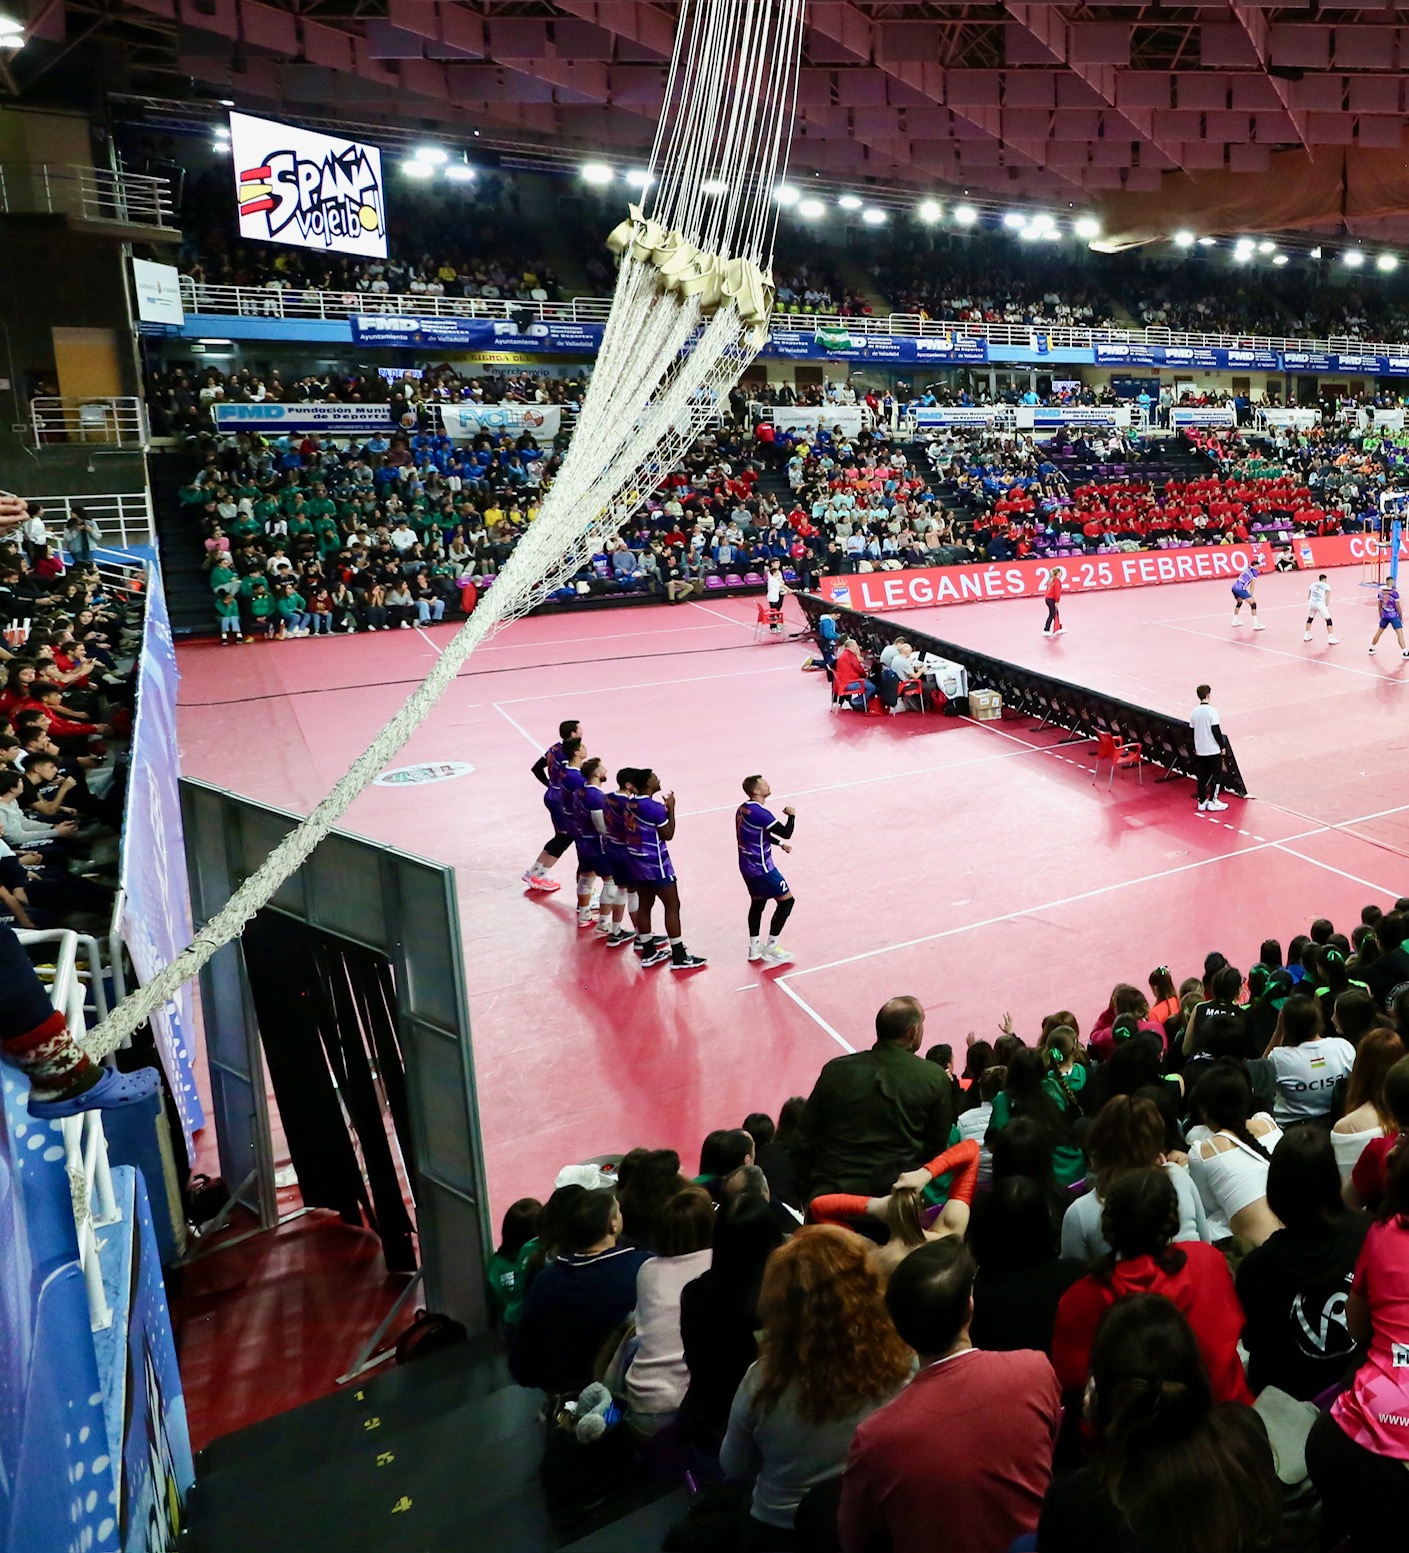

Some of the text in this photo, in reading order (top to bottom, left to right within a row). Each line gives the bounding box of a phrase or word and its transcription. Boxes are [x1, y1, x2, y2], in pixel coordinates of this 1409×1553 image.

[357, 317, 420, 331] FMD
[360, 333, 408, 341] Ayuntamiento
[494, 338, 539, 346] Ayuntamiento
[916, 339, 953, 351] FMD
[1097, 344, 1130, 356] FMD
[1164, 348, 1194, 359] FMD
[1228, 350, 1255, 361] FMD
[1284, 353, 1310, 363] FMD
[1338, 356, 1362, 366] FMD
[217, 405, 286, 420] FMD
[1034, 409, 1061, 418] FMD
[861, 565, 1032, 609] LEGANÉS
[1121, 550, 1249, 583] FEBRERO
